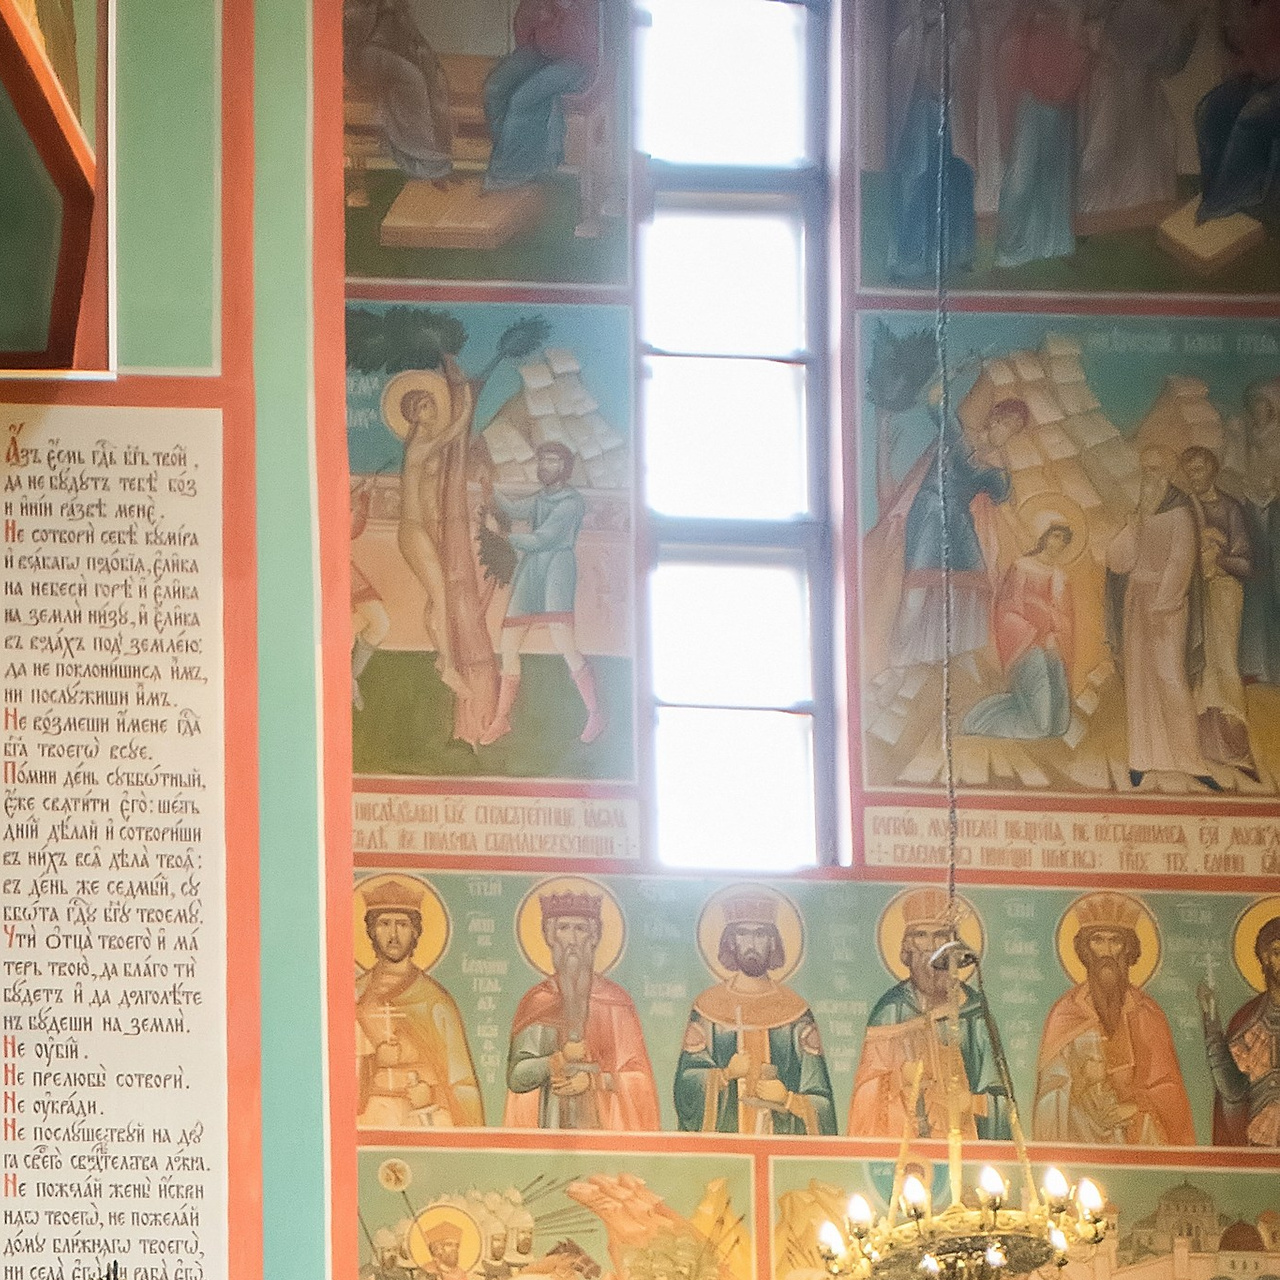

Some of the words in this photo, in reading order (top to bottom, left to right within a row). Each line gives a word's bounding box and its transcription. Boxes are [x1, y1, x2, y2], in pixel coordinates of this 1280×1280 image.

[4, 477, 22, 492] да
[28, 476, 44, 490] не
[5, 502, 12, 516] и
[5, 519, 24, 543] Не
[5, 581, 23, 596] на
[5, 608, 24, 625] на
[5, 635, 23, 650] въ
[5, 662, 27, 679] да
[33, 663, 49, 676] не
[5, 689, 22, 703] ни
[5, 707, 26, 730] Не
[3, 851, 21, 866] въ
[3, 879, 21, 894] въ
[76, 880, 99, 895] же
[3, 961, 42, 976] терь
[99, 963, 118, 981] да
[89, 989, 111, 1007] да
[4, 1015, 23, 1030] нъ
[103, 1017, 125, 1034] на
[4, 1035, 25, 1058] Не
[4, 1063, 25, 1086] Не
[4, 1091, 25, 1113] Не
[4, 1117, 25, 1141] Не
[153, 1129, 171, 1143] на
[4, 1154, 18, 1169] га
[4, 1173, 26, 1197] Не
[109, 1212, 125, 1226] не
[4, 1266, 23, 1280] ни
